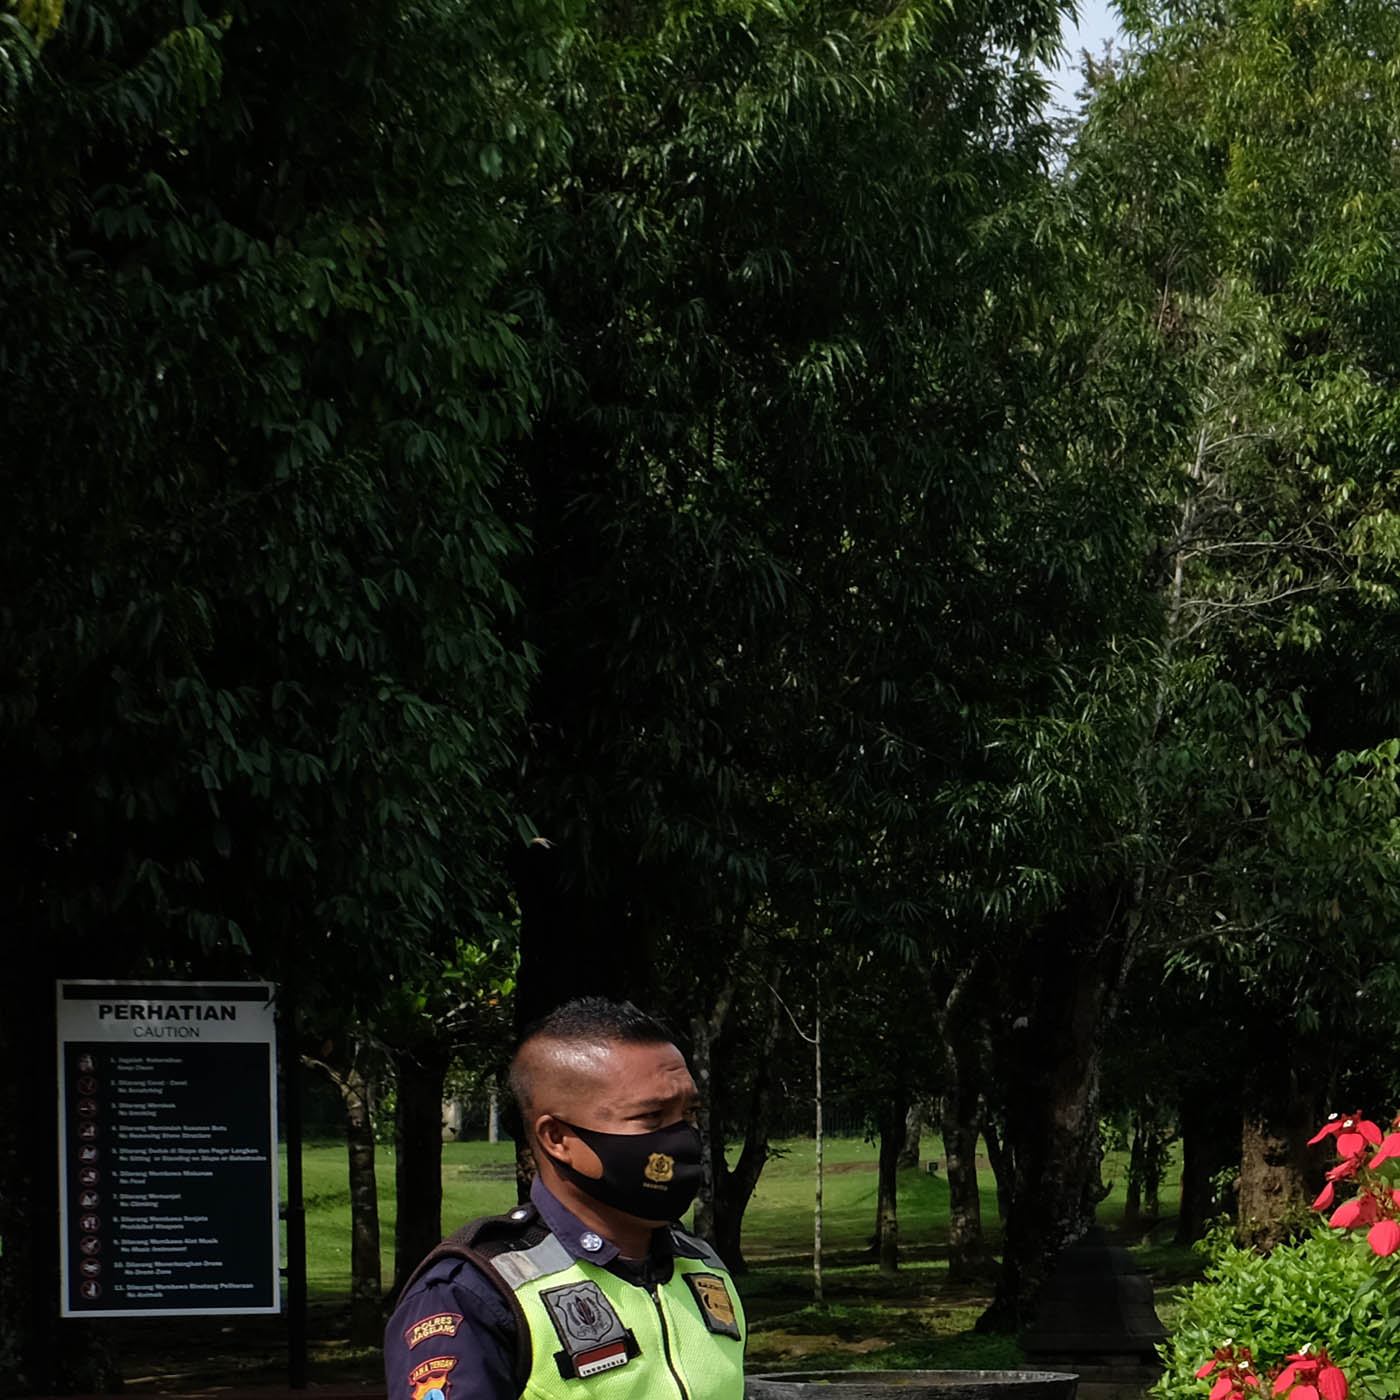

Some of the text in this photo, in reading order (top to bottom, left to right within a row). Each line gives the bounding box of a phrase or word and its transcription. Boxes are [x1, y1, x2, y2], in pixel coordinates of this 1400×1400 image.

[99, 1004, 236, 1021] PERHATIAN
[133, 1026, 200, 1039] CAUTION
[414, 1316, 452, 1336] POLRES
